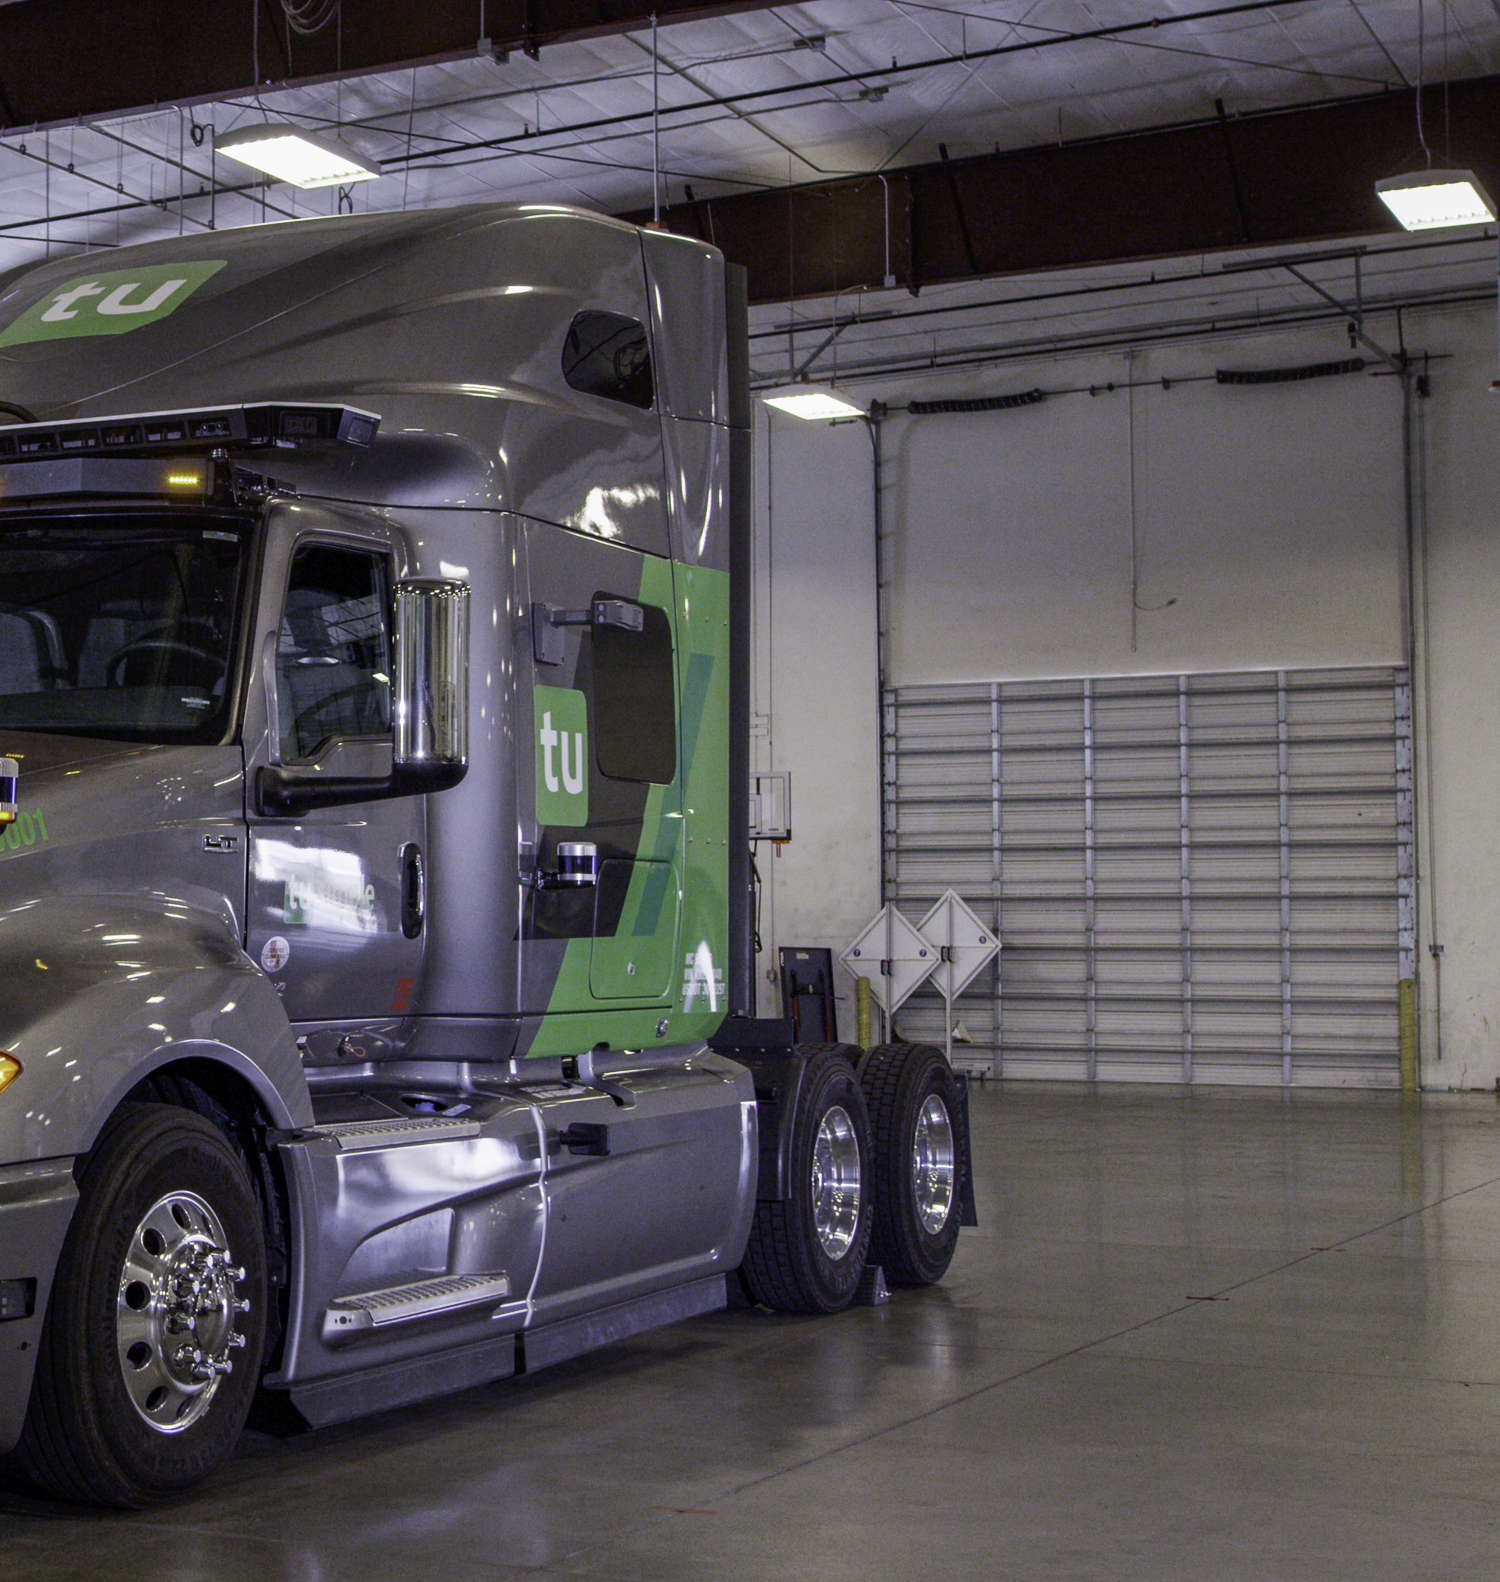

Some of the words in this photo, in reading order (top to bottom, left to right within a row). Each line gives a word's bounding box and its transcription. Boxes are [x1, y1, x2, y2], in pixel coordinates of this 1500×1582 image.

[41, 279, 188, 322] tu
[540, 711, 583, 795] tu
[203, 834, 239, 853] LT
